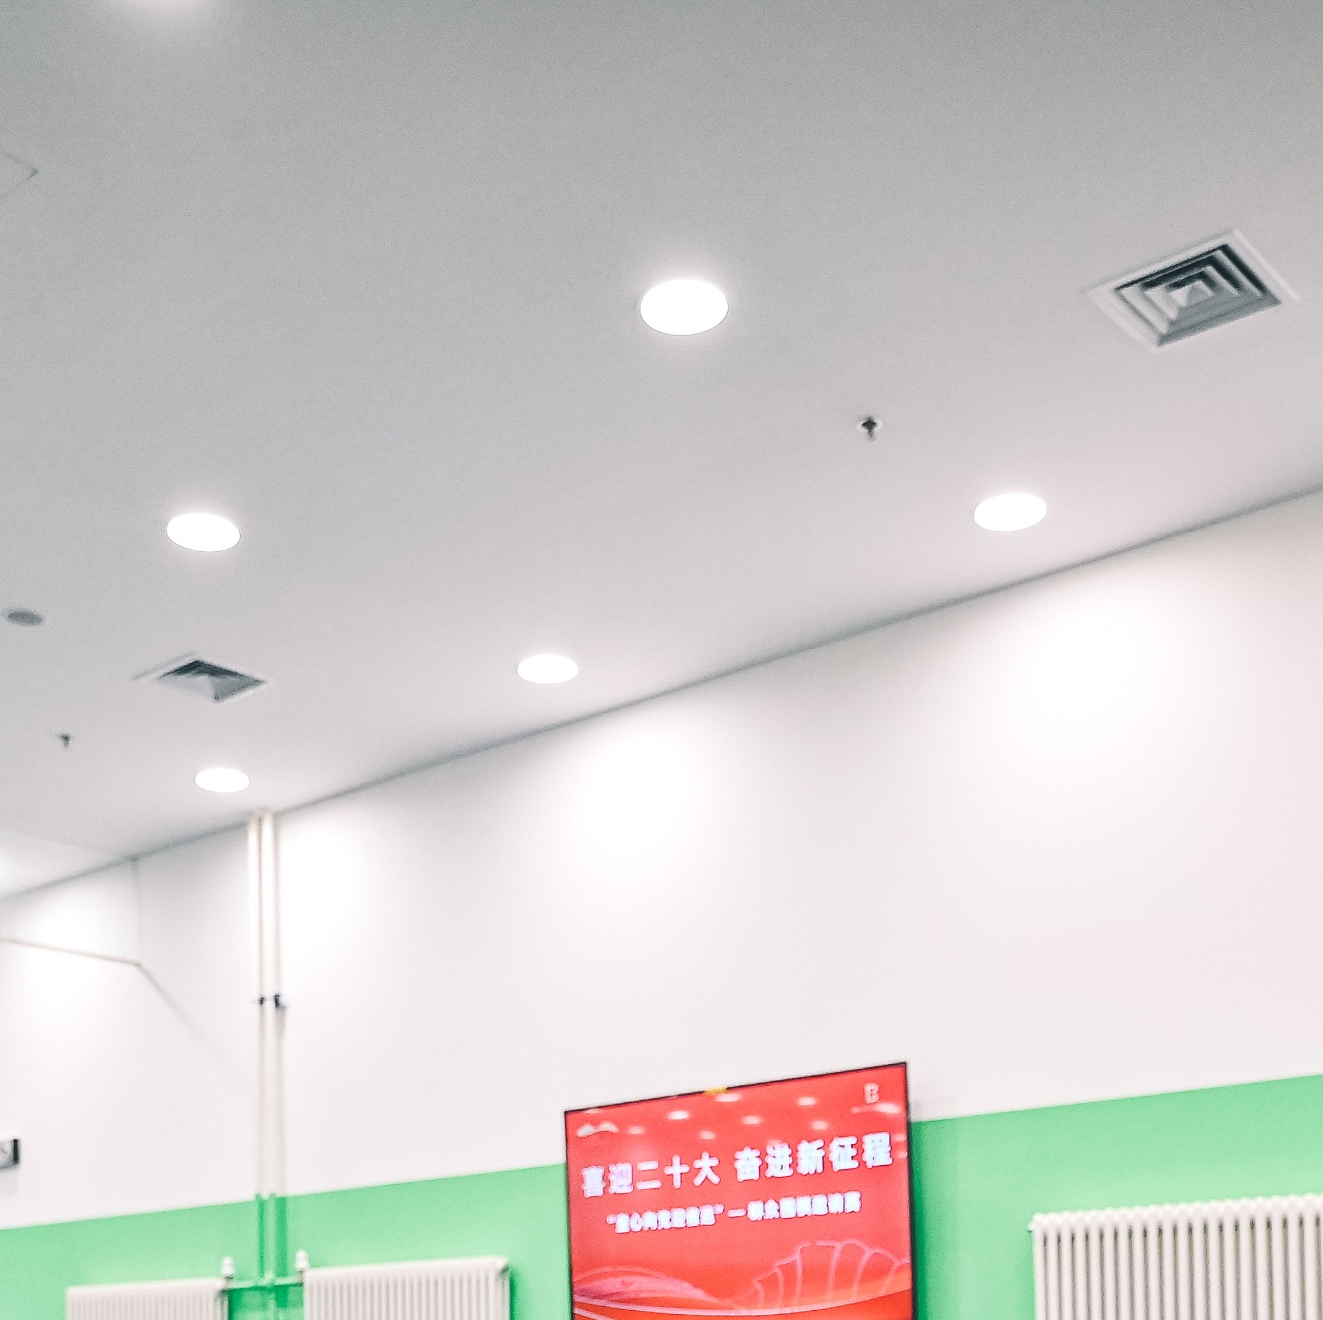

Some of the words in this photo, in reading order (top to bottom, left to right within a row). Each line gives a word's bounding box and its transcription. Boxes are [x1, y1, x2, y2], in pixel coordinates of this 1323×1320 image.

[581, 1151, 721, 1198] 喜迎二十大
[734, 1131, 893, 1182] 奋进新征程
